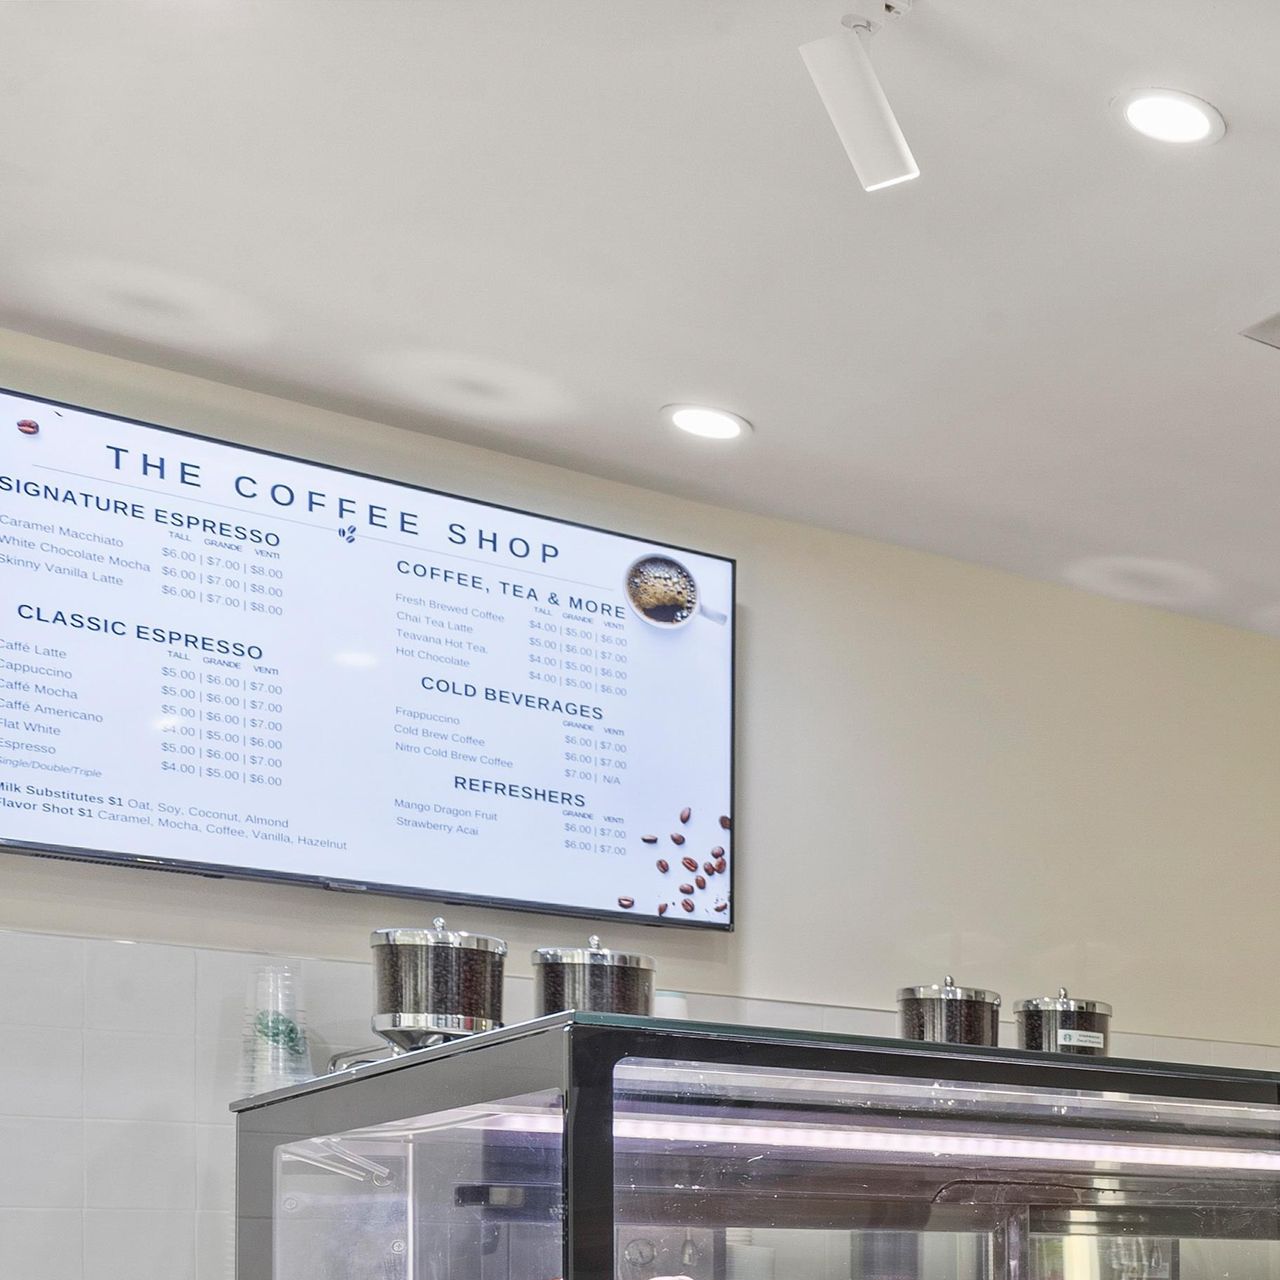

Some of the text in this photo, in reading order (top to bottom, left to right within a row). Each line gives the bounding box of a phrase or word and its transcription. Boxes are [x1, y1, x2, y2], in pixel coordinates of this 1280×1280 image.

[0, 475, 280, 548] SIGNATURE ESPRESSO
[105, 445, 560, 565] THE COFFEE SHOP
[0, 514, 124, 549] Caramel Macchiato
[168, 531, 192, 542] TALL
[203, 537, 243, 553] GRANDE
[40, 541, 105, 565] Chocolate
[108, 555, 151, 573] Mocha
[161, 547, 283, 580] $6.00 $7.00 $8.00
[44, 562, 88, 581] Vanilla
[91, 570, 124, 587] Latte
[161, 565, 283, 599] $6.00 $7.00 $8.00
[397, 560, 626, 620] COFFEE, TEA & MORE
[395, 592, 505, 623] Fresh Brewed Coffee
[17, 604, 263, 660] CLASSIC ESPRESSO
[425, 617, 445, 629] Tea
[448, 622, 474, 635] Latte
[34, 644, 67, 659] Latte
[395, 646, 471, 669] Hot Chocolate
[34, 683, 78, 700] Mocha
[160, 666, 283, 696] $5.00 $6.00 $7.00
[34, 702, 104, 724] Americano
[421, 676, 604, 721] COLD BEVERAGES
[23, 721, 61, 737] White
[395, 706, 460, 727] Frappuccino
[394, 724, 486, 748] Cold Brew Coffee
[395, 742, 514, 770] Nitro Cold Brew Coffee
[26, 785, 104, 806] Substitutes
[108, 796, 123, 807] $1
[245, 814, 289, 829] Almond
[454, 776, 586, 808] REFRESHERS
[394, 799, 498, 822] Mango Dragon Fruit
[396, 816, 453, 835] Strawberry
[42, 802, 74, 817] Shot
[78, 807, 93, 819] $1
[298, 836, 347, 851] Hazelnut
